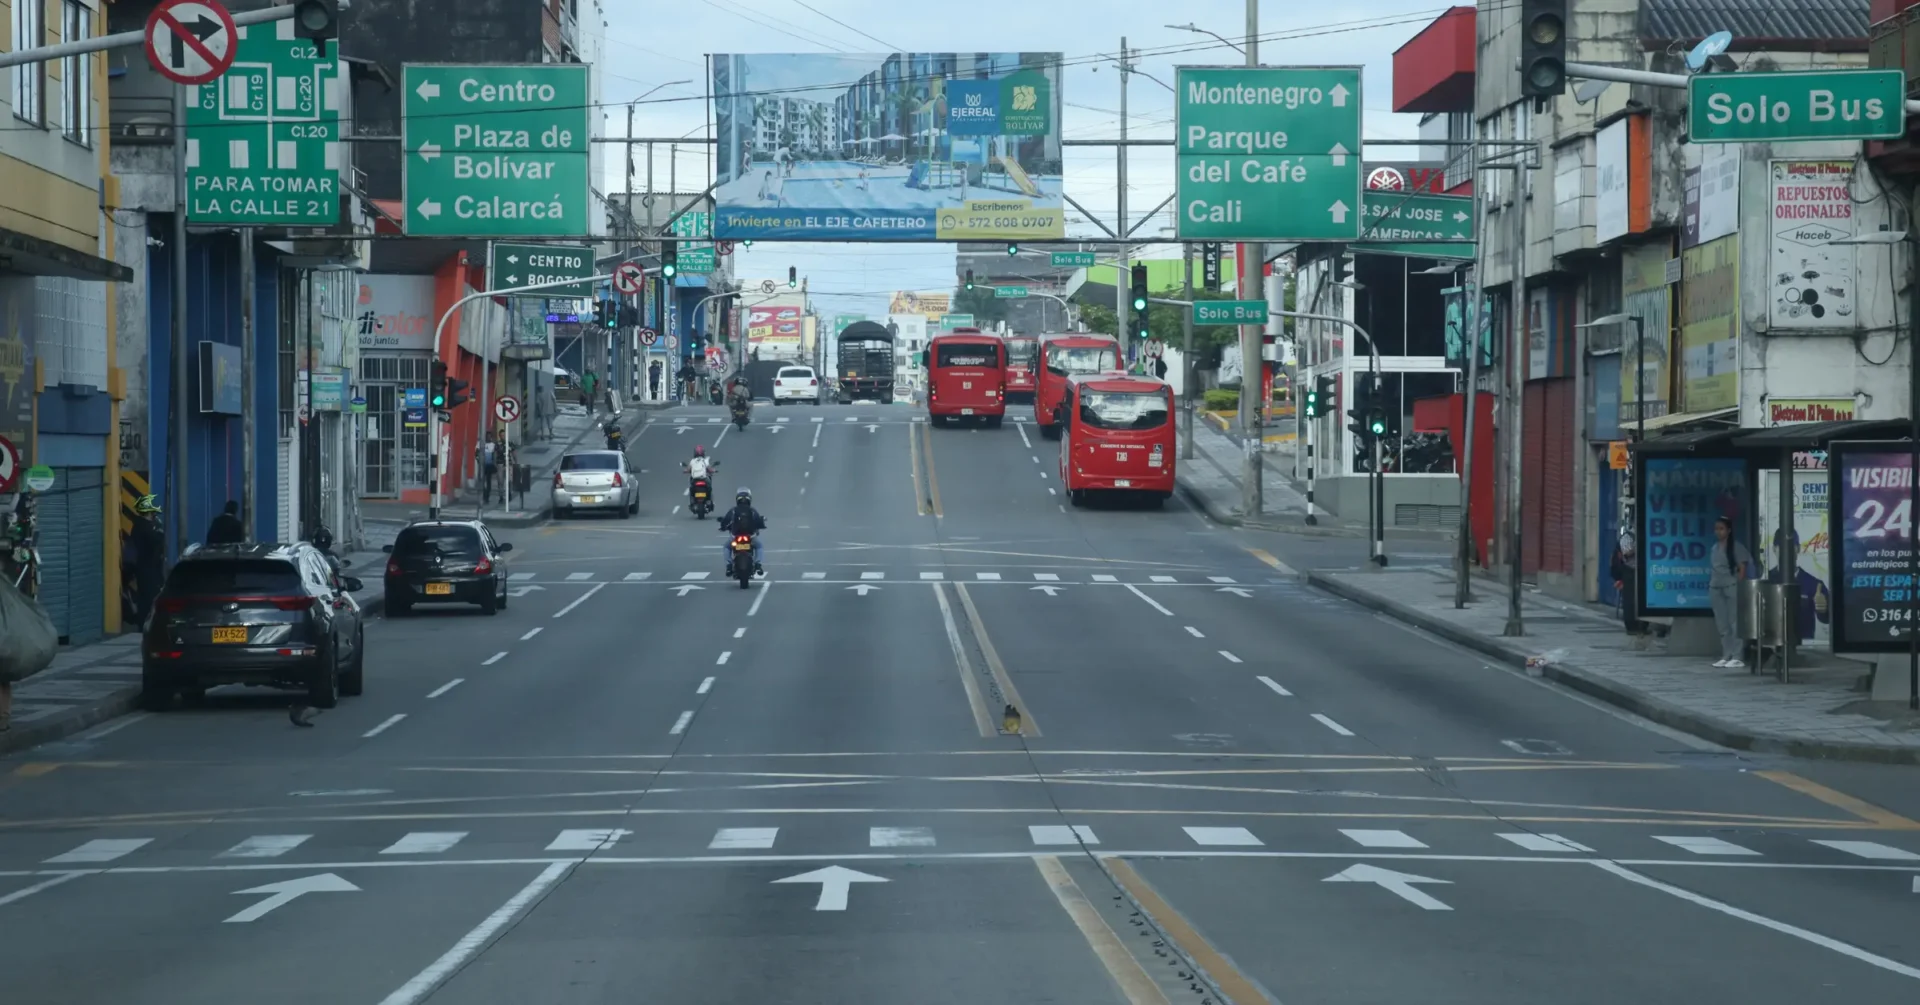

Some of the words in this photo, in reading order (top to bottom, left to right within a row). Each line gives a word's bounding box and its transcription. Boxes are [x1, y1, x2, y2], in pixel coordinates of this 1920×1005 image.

[290, 47, 317, 59] Cl.2
[300, 75, 312, 112] Cr.20
[459, 78, 555, 102] Centro
[1188, 81, 1323, 110] Montenegro
[951, 107, 996, 119] EJEREAL
[1706, 91, 1791, 125] Solo
[1808, 89, 1884, 122] Bus
[291, 125, 328, 138] Cl.20
[1005, 121, 1044, 130] BOLÍVAR
[454, 124, 530, 148] Plaza
[541, 124, 572, 148] de
[1188, 125, 1288, 154] Parque
[454, 155, 555, 179] Bolívar
[1188, 159, 1230, 183] del
[1241, 156, 1307, 183] Café
[195, 176, 255, 192] PARA
[260, 177, 332, 193] TOMAR
[1777, 186, 1850, 201] REPUESTOS
[195, 199, 222, 214] LA
[230, 199, 298, 215] CALLE
[306, 200, 329, 215] 21
[454, 193, 563, 219] Calarcá
[971, 202, 1024, 212] Escríbenos
[1188, 199, 1242, 223] Cali
[1775, 204, 1851, 219] ORIGINALES
[728, 215, 781, 228] Invierte
[784, 218, 802, 228] en
[805, 217, 823, 228] EL
[826, 217, 849, 228] EJE
[852, 217, 927, 228] CAFETERO
[968, 217, 991, 228] 572
[994, 217, 1020, 228] 608
[1022, 216, 1054, 228] 0707
[1405, 208, 1443, 222] JOSE
[1795, 230, 1832, 240] Haceb
[529, 255, 581, 268] CENTRO
[528, 273, 581, 288] BOGOTA
[1199, 307, 1230, 319] Solo
[1234, 306, 1262, 318] Bus
[751, 328, 766, 337] CAR
[374, 335, 399, 346] juntos
[1649, 493, 1707, 514] VISI
[1854, 499, 1912, 538] 24
[1649, 518, 1706, 537] BILI
[1649, 542, 1706, 561] DAD
[1883, 549, 1895, 557] los
[1897, 551, 1912, 560] pu
[1852, 559, 1909, 570] estratégicos
[1883, 590, 1905, 601] SER
[1879, 609, 1902, 621] 316
